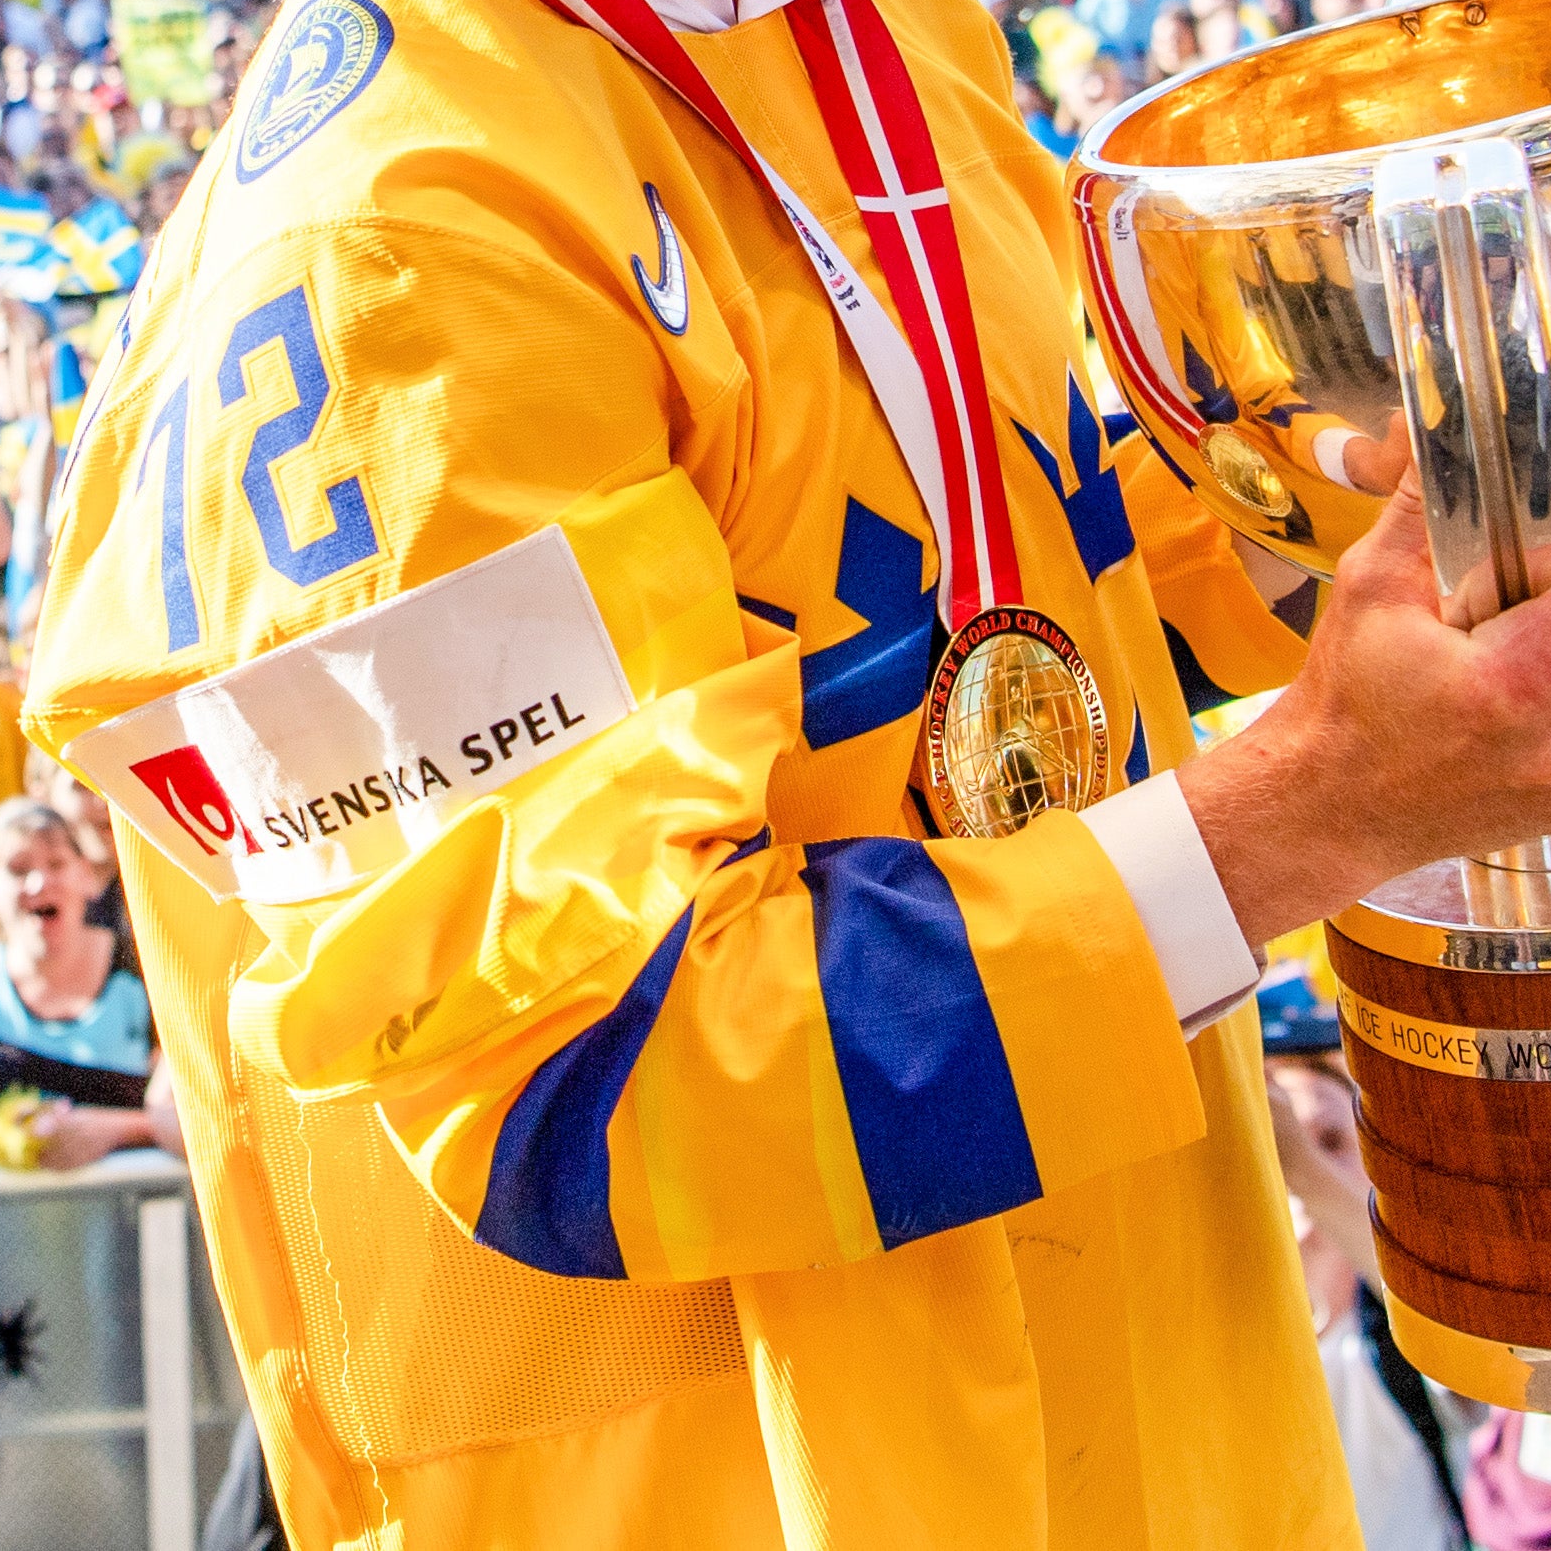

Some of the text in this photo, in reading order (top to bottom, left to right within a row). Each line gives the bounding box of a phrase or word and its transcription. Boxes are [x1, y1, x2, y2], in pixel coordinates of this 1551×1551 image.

[930, 657, 959, 760] HOCKEY
[955, 612, 1012, 658] WORLD
[1015, 611, 1107, 748] CHAMPIONSHIP
[264, 692, 587, 849] SVENSKA SPEL
[1355, 1001, 1383, 1041] ICE
[1390, 1021, 1488, 1066] HOCKEY
